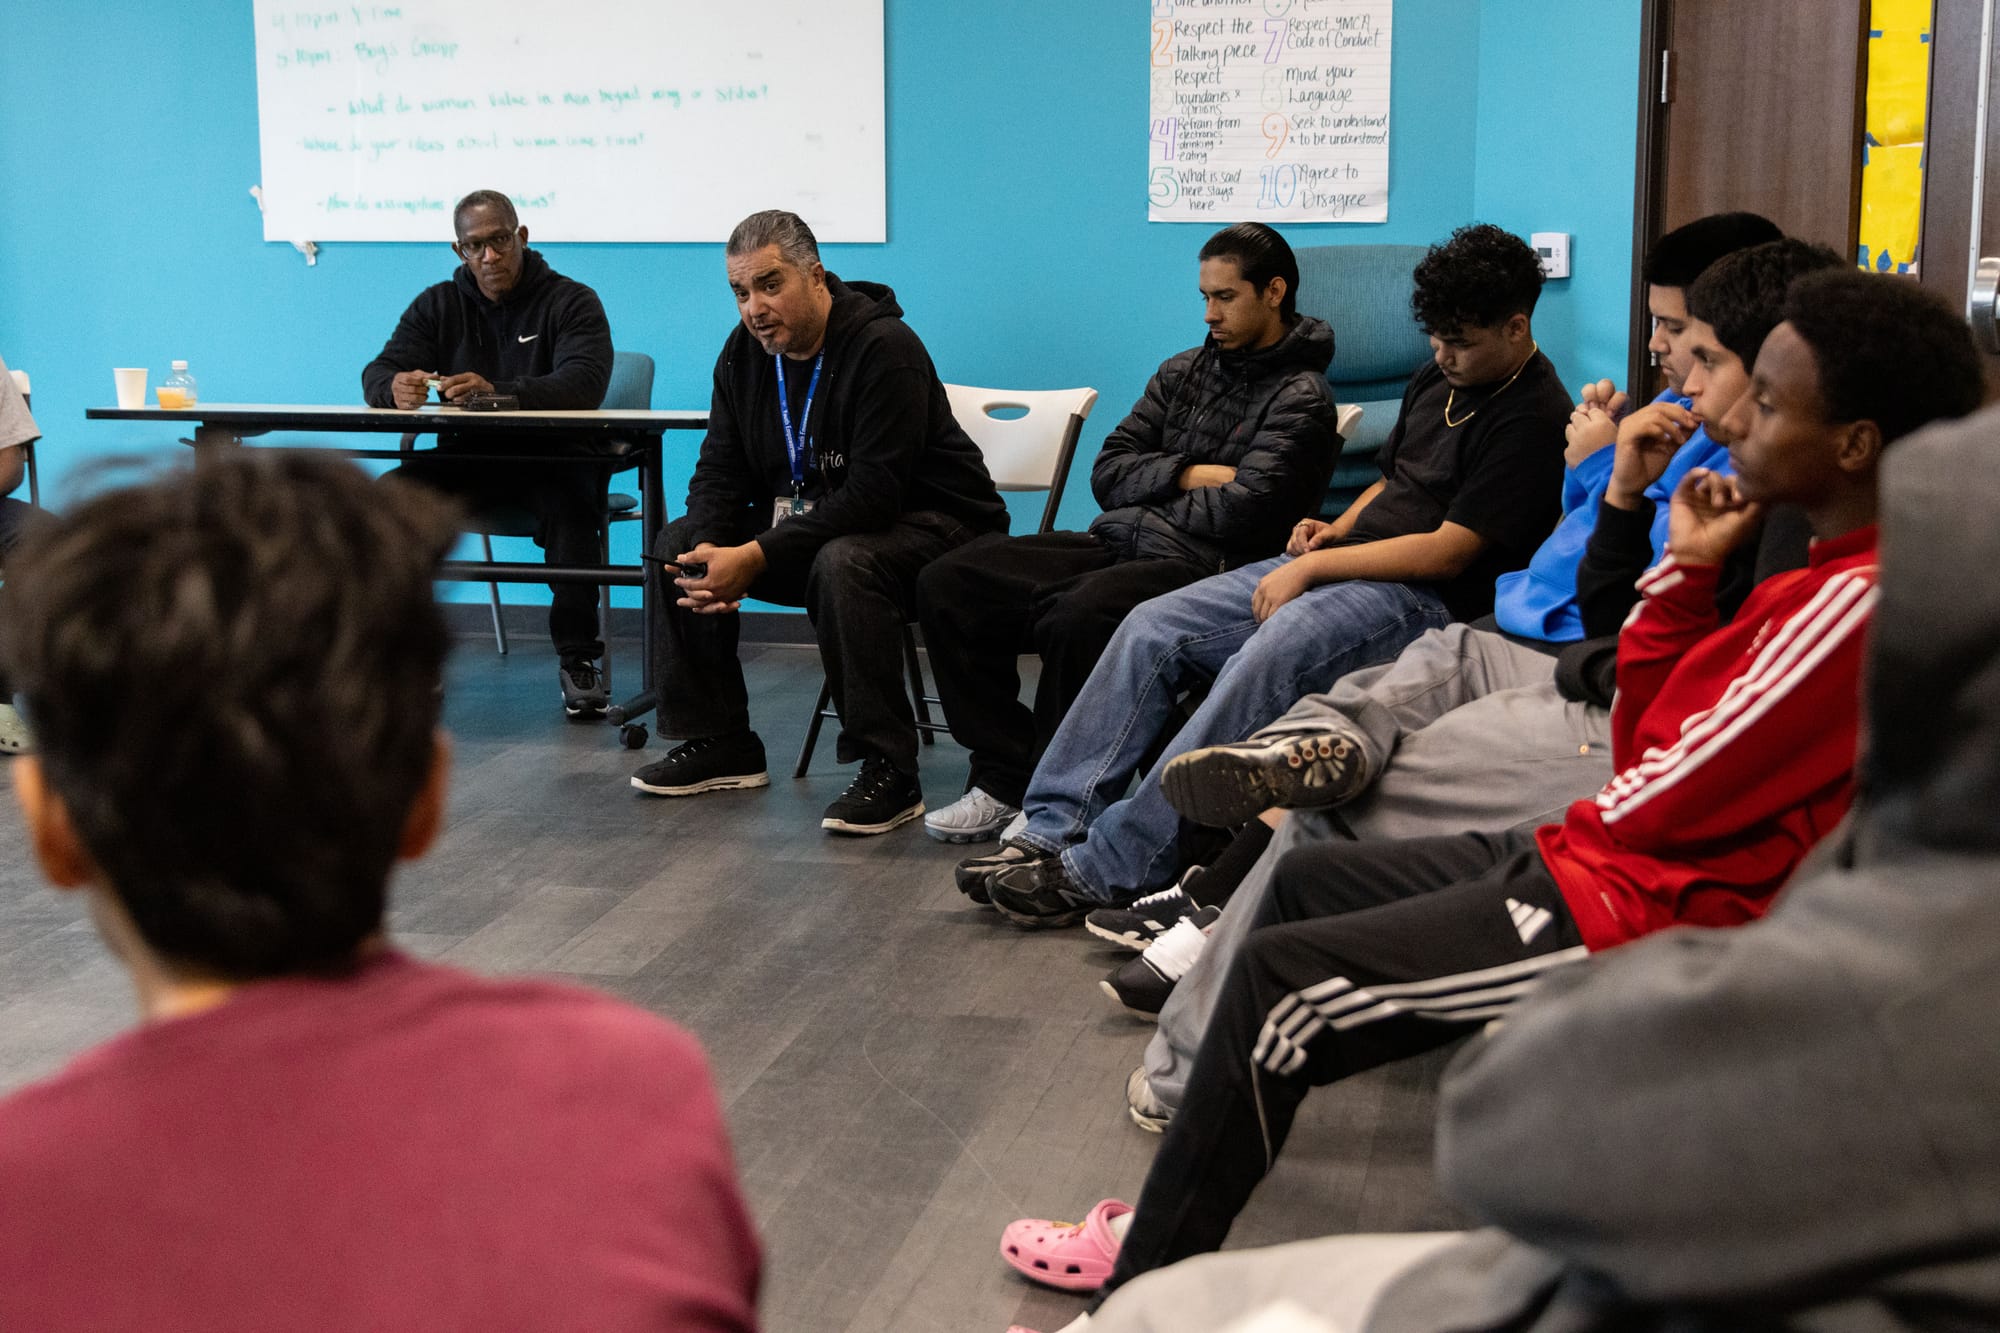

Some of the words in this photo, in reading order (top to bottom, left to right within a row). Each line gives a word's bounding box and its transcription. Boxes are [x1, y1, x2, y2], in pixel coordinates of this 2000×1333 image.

[1151, 20, 1174, 67] 2
[1174, 19, 1223, 43] Respect
[1232, 18, 1255, 35] the
[1264, 19, 1288, 64] 7
[1289, 16, 1329, 34] Respect
[1287, 31, 1314, 49] Code
[1319, 29, 1331, 48] of
[1335, 27, 1385, 49] Conduct
[1177, 45, 1219, 69] talking
[1223, 44, 1257, 66] piece
[1175, 66, 1224, 88] Respect
[1286, 65, 1320, 86] Mind
[1326, 66, 1357, 87] your
[1175, 90, 1230, 105] boundaries
[1289, 87, 1353, 113] Language
[1181, 104, 1222, 118] opinions
[1150, 117, 1177, 160] 4
[1178, 116, 1212, 131] Refrain
[1217, 116, 1241, 130] from
[1262, 113, 1288, 160] 9
[1290, 114, 1315, 131] Seek
[1321, 115, 1331, 129] to
[1333, 113, 1387, 129] understand
[1300, 132, 1310, 146] to
[1313, 132, 1326, 146] be
[1329, 130, 1387, 146] understood
[1149, 167, 1179, 209] 5
[1178, 168, 1206, 184] What
[1210, 171, 1218, 183] is
[1221, 168, 1242, 184] said
[1182, 185, 1203, 197] here
[1208, 185, 1234, 203] stays
[1257, 164, 1296, 210] 10
[1292, 163, 1338, 189] Agree
[1344, 162, 1359, 180] to
[1189, 198, 1217, 211] here
[1301, 189, 1368, 218] Disagree
